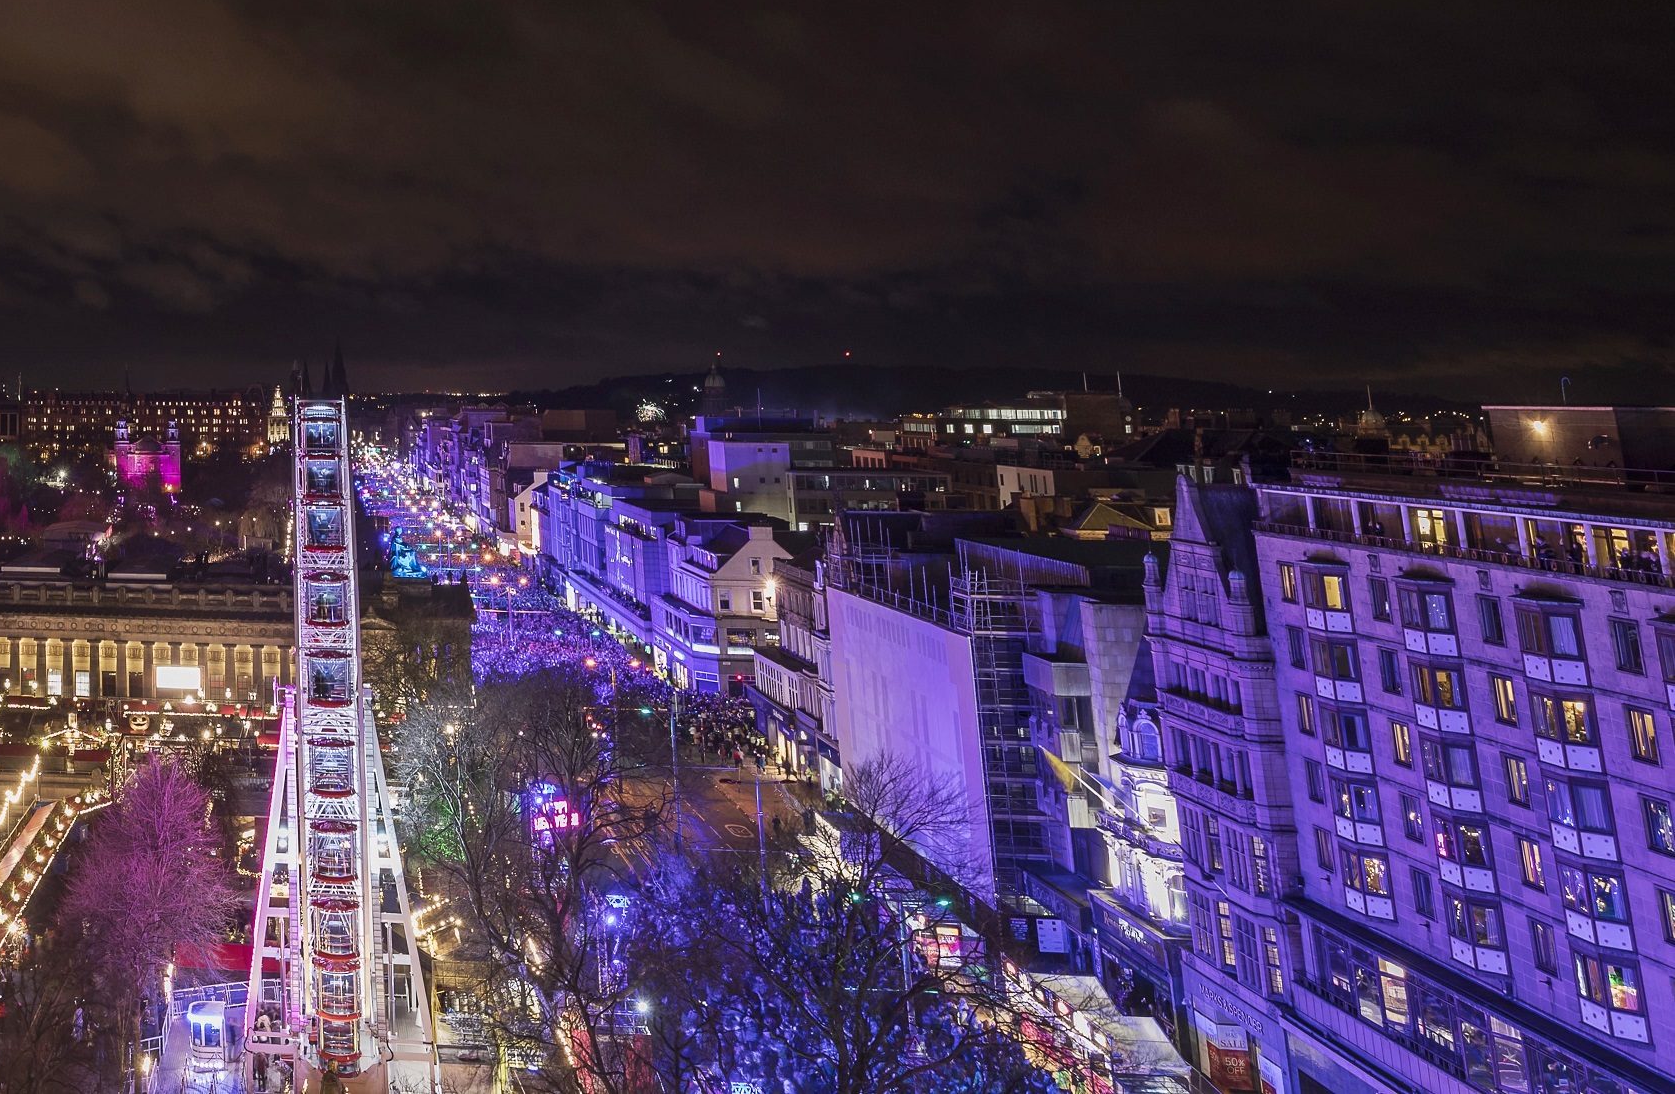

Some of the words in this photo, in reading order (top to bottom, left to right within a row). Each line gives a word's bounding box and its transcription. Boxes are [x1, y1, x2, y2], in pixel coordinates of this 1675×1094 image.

[1199, 983, 1223, 1008] MARKS
[1228, 1003, 1264, 1035] SPENCER
[1225, 1057, 1245, 1066] 50%
[1227, 1066, 1244, 1074] OFF
